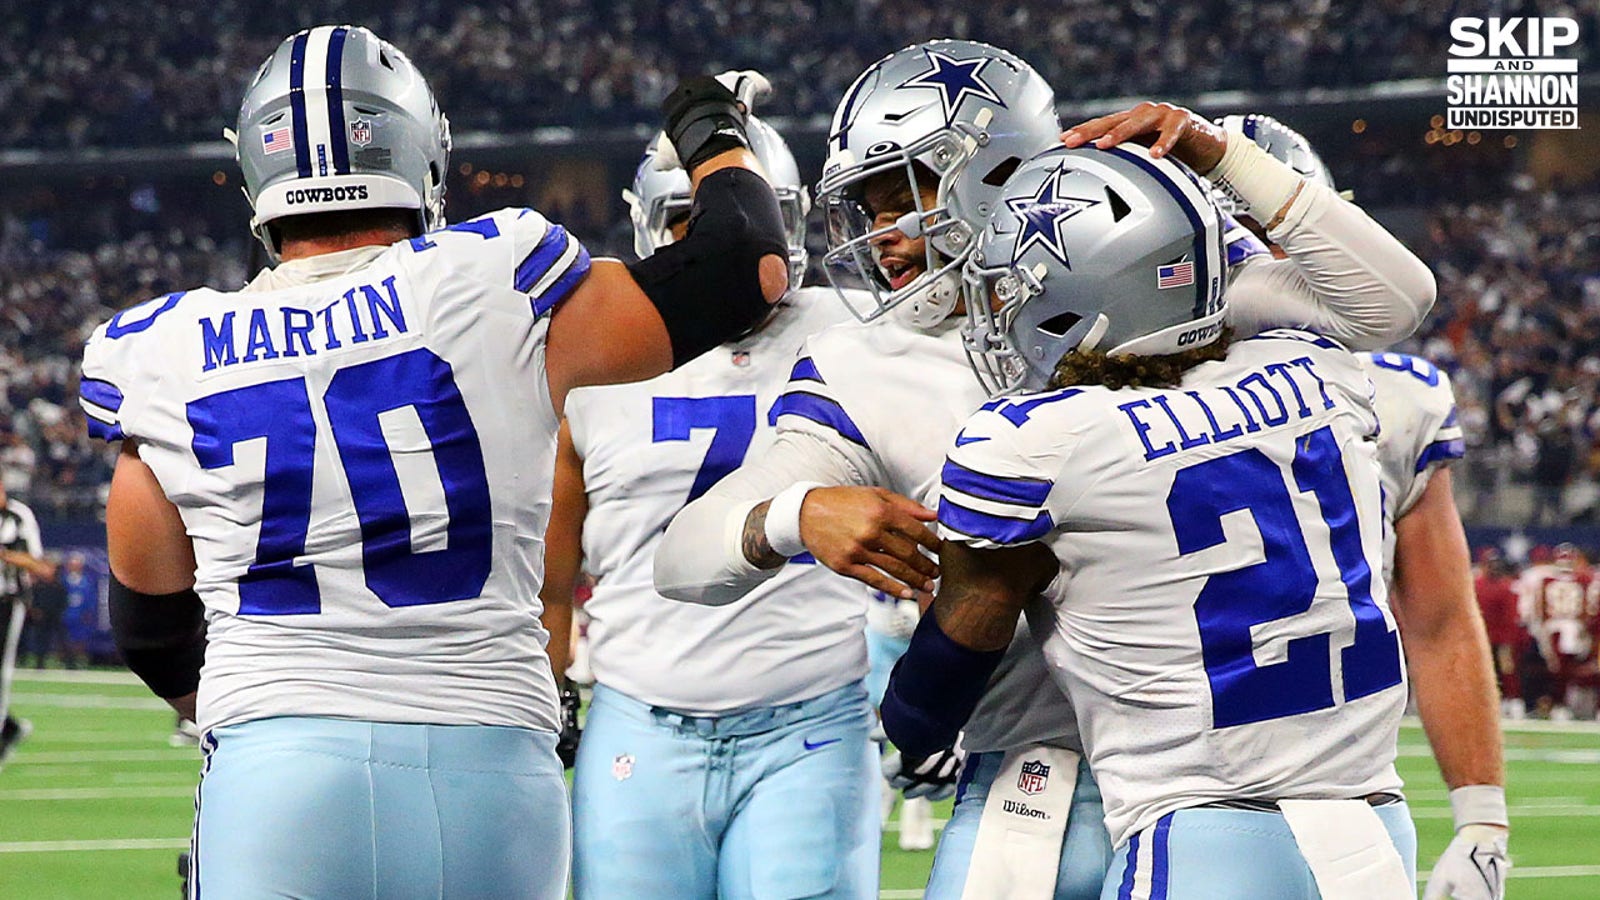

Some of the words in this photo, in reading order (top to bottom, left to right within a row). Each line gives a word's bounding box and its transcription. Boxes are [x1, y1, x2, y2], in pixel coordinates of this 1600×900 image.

[353, 130, 370, 141] NFL
[286, 185, 368, 204] COWBOYS
[199, 276, 407, 372] MARTIN
[1117, 357, 1336, 462] ELLIOTT
[185, 347, 492, 615] 70
[1165, 425, 1402, 729] 21
[1003, 800, 1047, 820] Wilson
[1020, 773, 1043, 792] NFL
